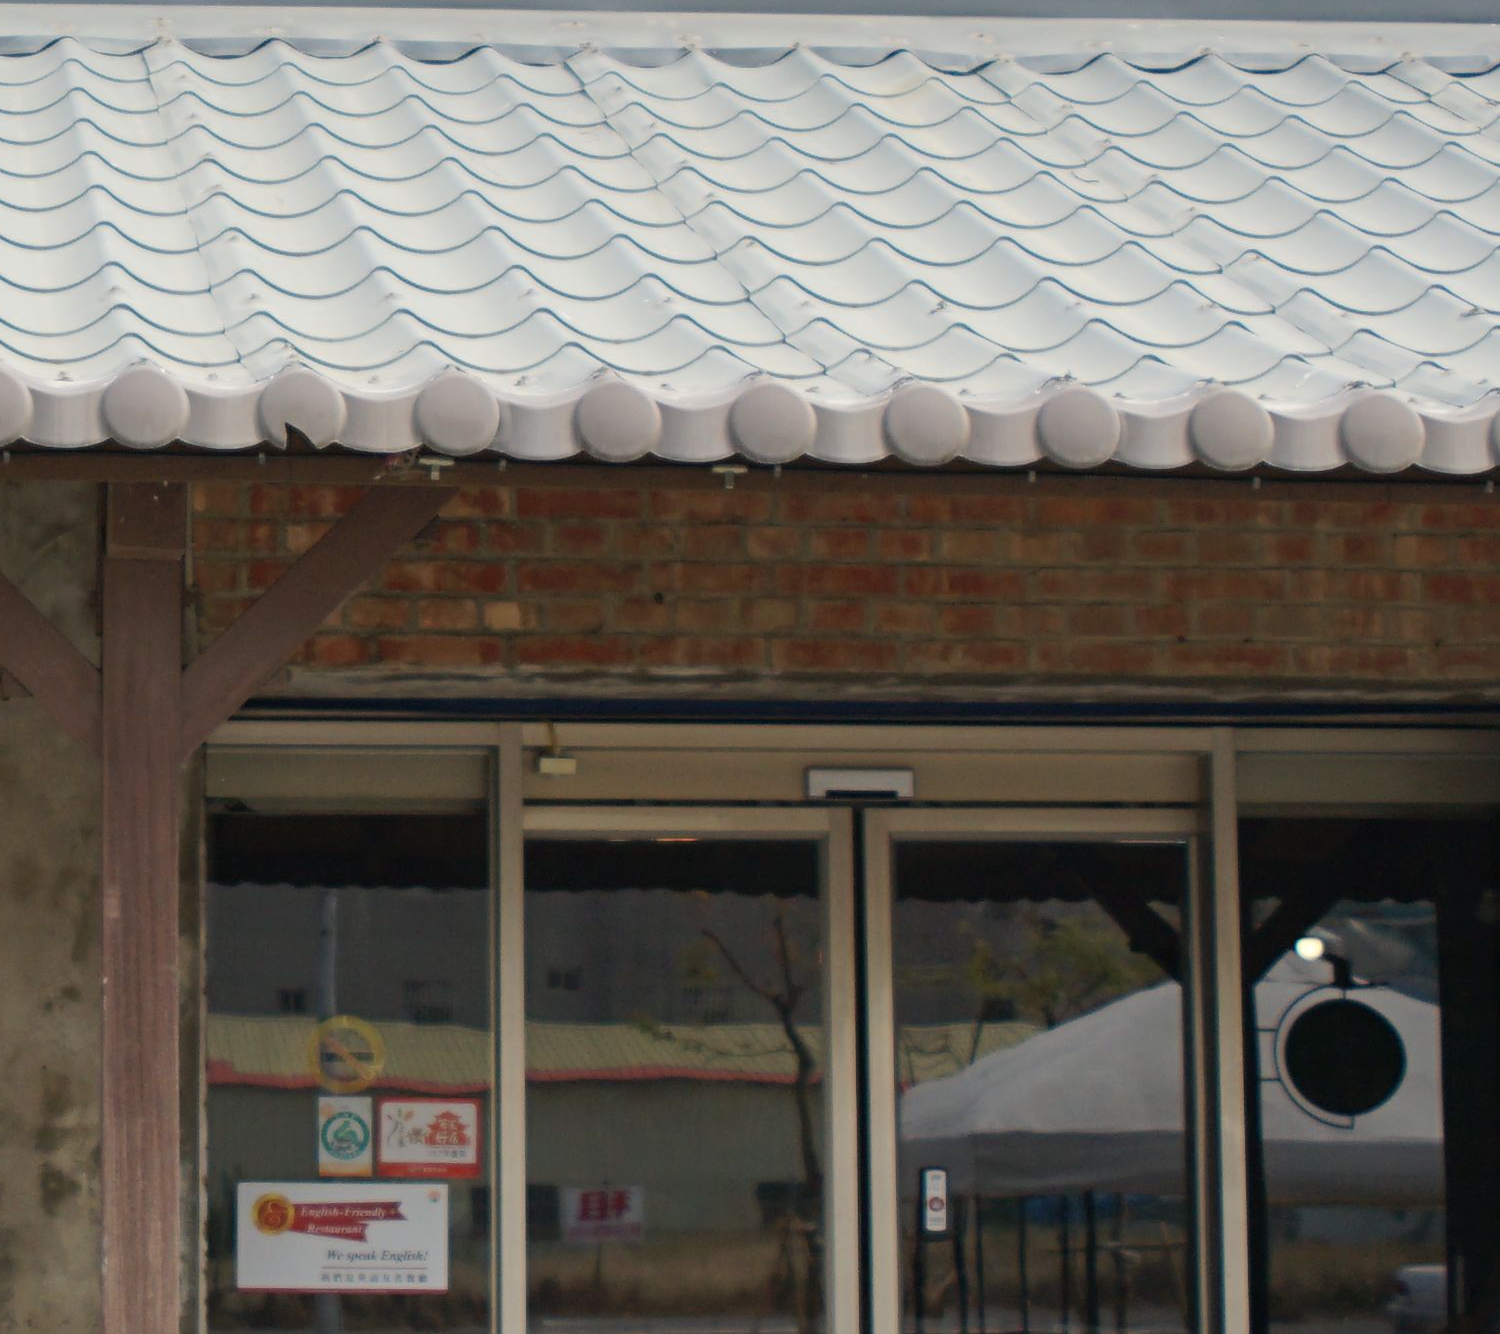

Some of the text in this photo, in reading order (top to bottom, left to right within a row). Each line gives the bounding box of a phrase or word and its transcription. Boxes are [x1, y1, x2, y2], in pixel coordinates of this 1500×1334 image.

[301, 1206, 386, 1220] English-Friendly
[306, 1223, 363, 1235] Restaurant
[327, 1249, 429, 1263] We speak English!
